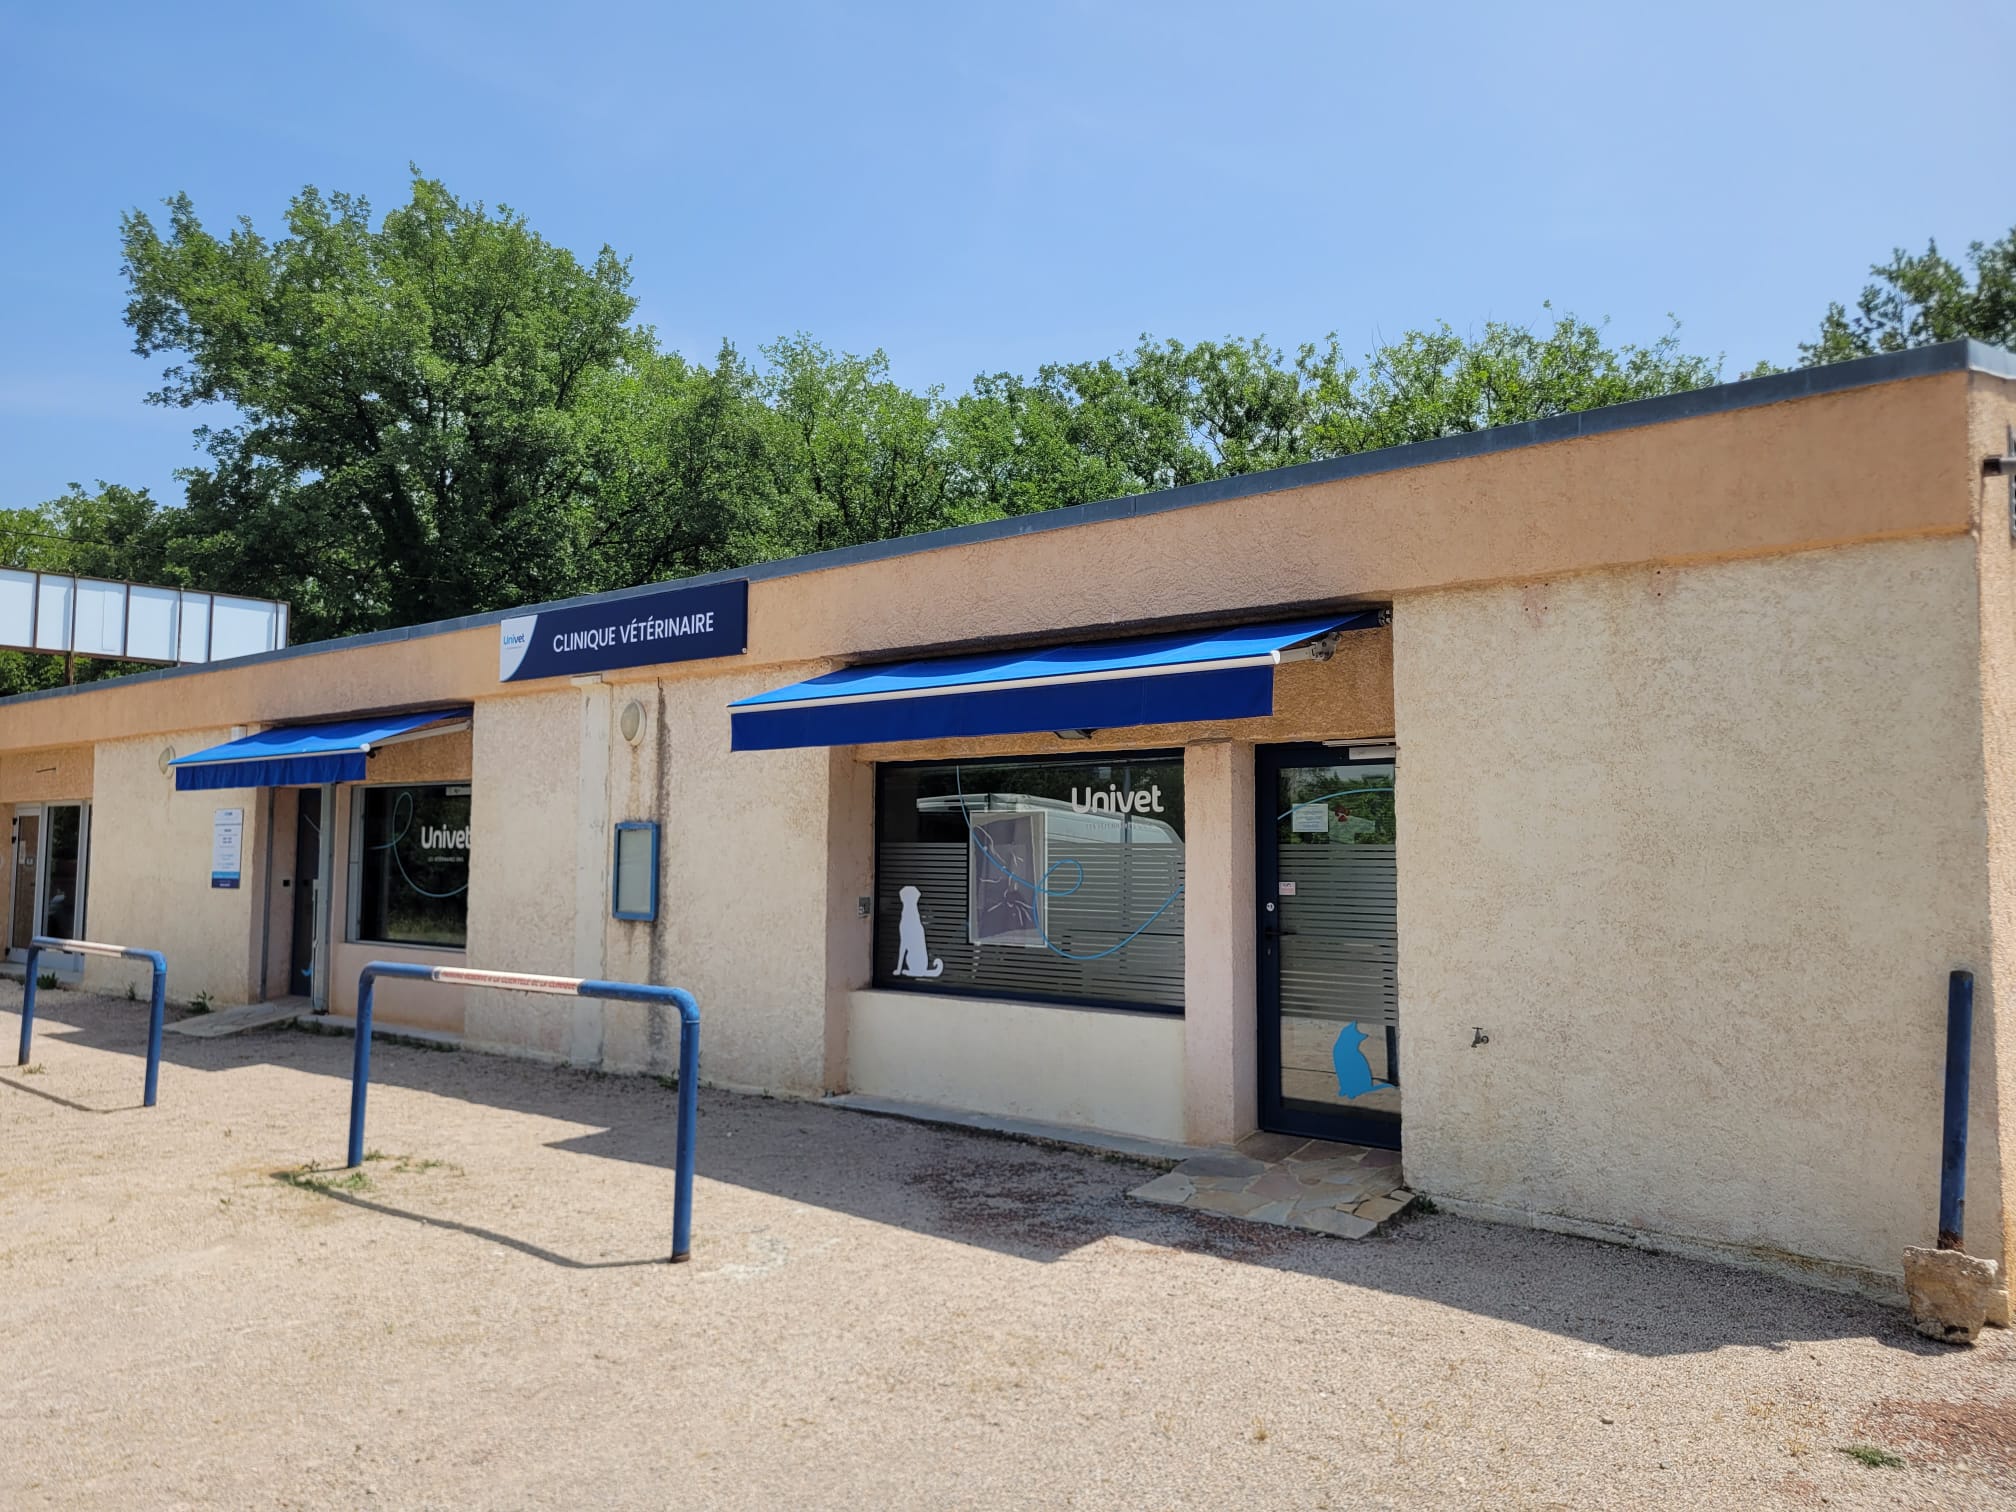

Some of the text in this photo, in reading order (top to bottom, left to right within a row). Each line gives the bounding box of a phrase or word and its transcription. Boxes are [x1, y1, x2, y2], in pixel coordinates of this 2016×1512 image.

[553, 612, 715, 653] CLINIQUE VÉTÉRINAIRE
[1071, 783, 1165, 814] Univet
[421, 823, 471, 850] Univet
